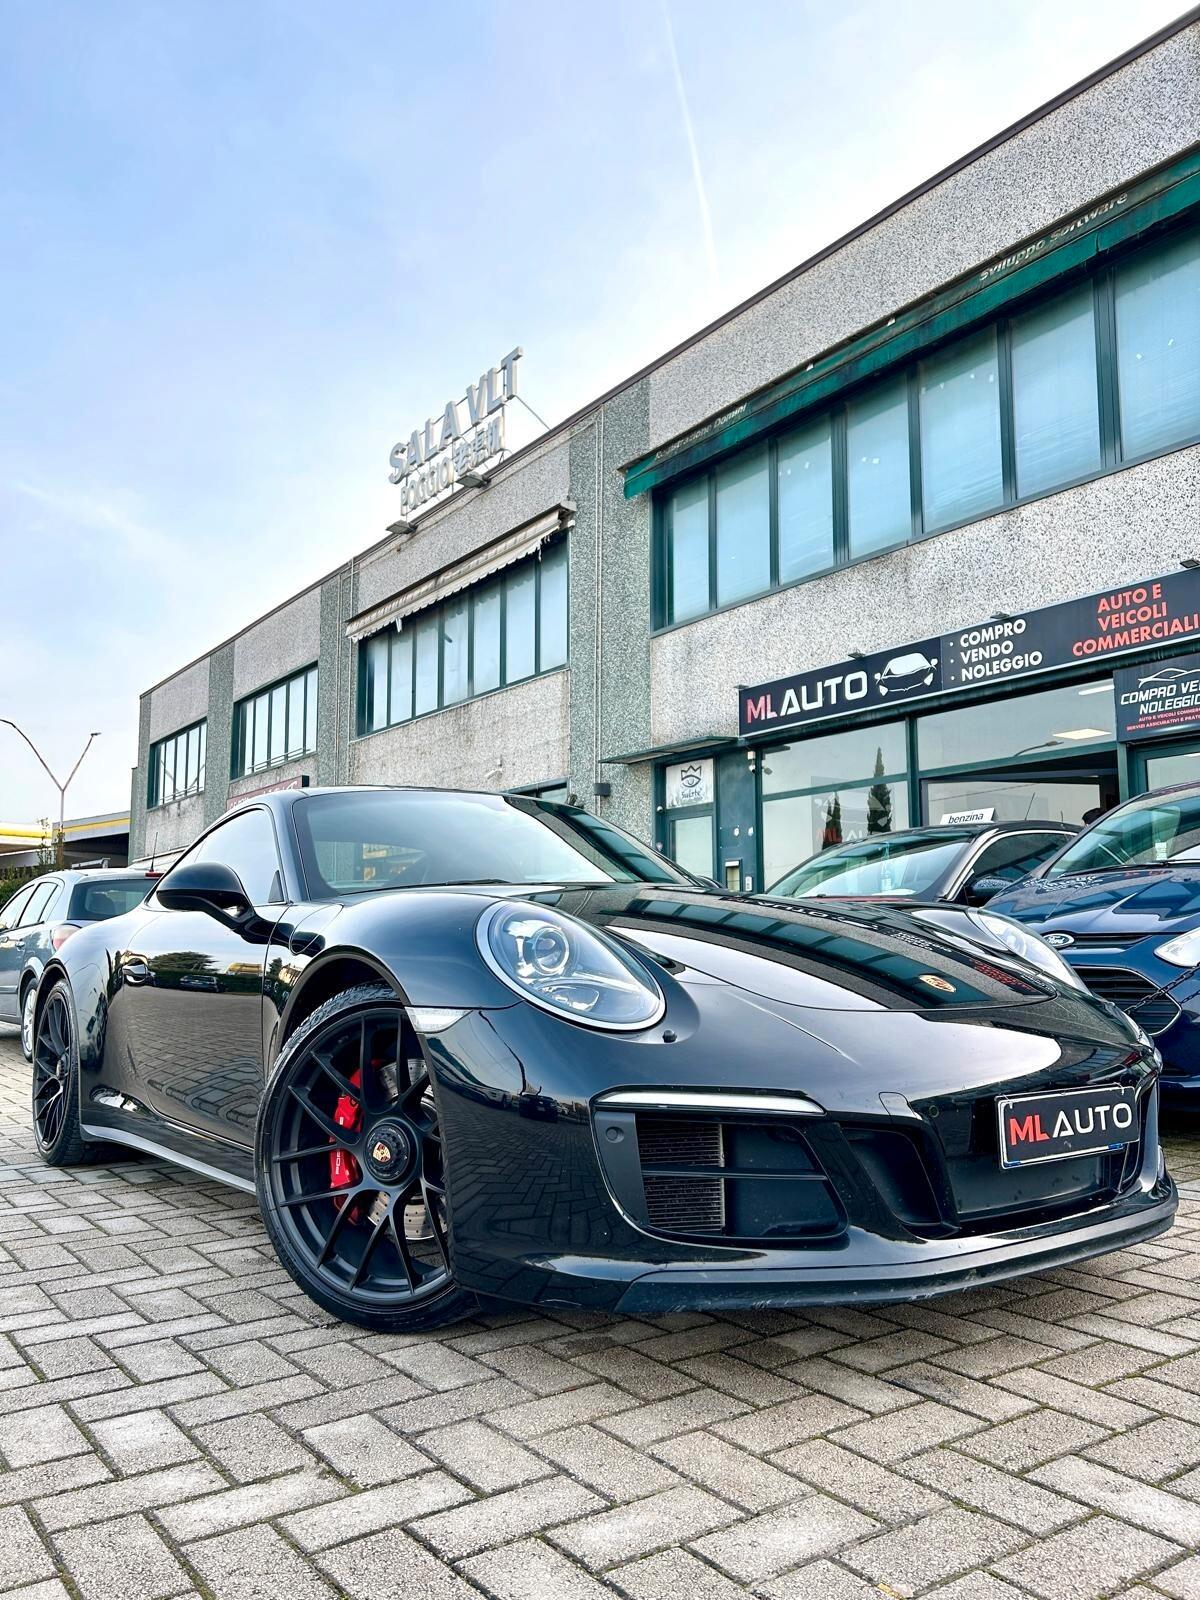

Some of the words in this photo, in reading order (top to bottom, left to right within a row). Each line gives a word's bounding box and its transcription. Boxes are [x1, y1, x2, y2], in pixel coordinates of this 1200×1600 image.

[388, 400, 463, 485] SALA
[466, 346, 524, 427] VLT
[400, 456, 455, 516] POGGIO
[1097, 588, 1147, 614] AUTO
[1151, 583, 1162, 600] E
[1097, 602, 1167, 632] VEICOLI
[960, 619, 1027, 648] COMPRO
[1072, 613, 1199, 657] COMMERCIALI
[960, 640, 1014, 665] VENDO
[961, 651, 1043, 682] NOLEGGIO
[1120, 684, 1177, 705] COMPRO
[1181, 680, 1200, 694] VE
[948, 812, 985, 824] benzina
